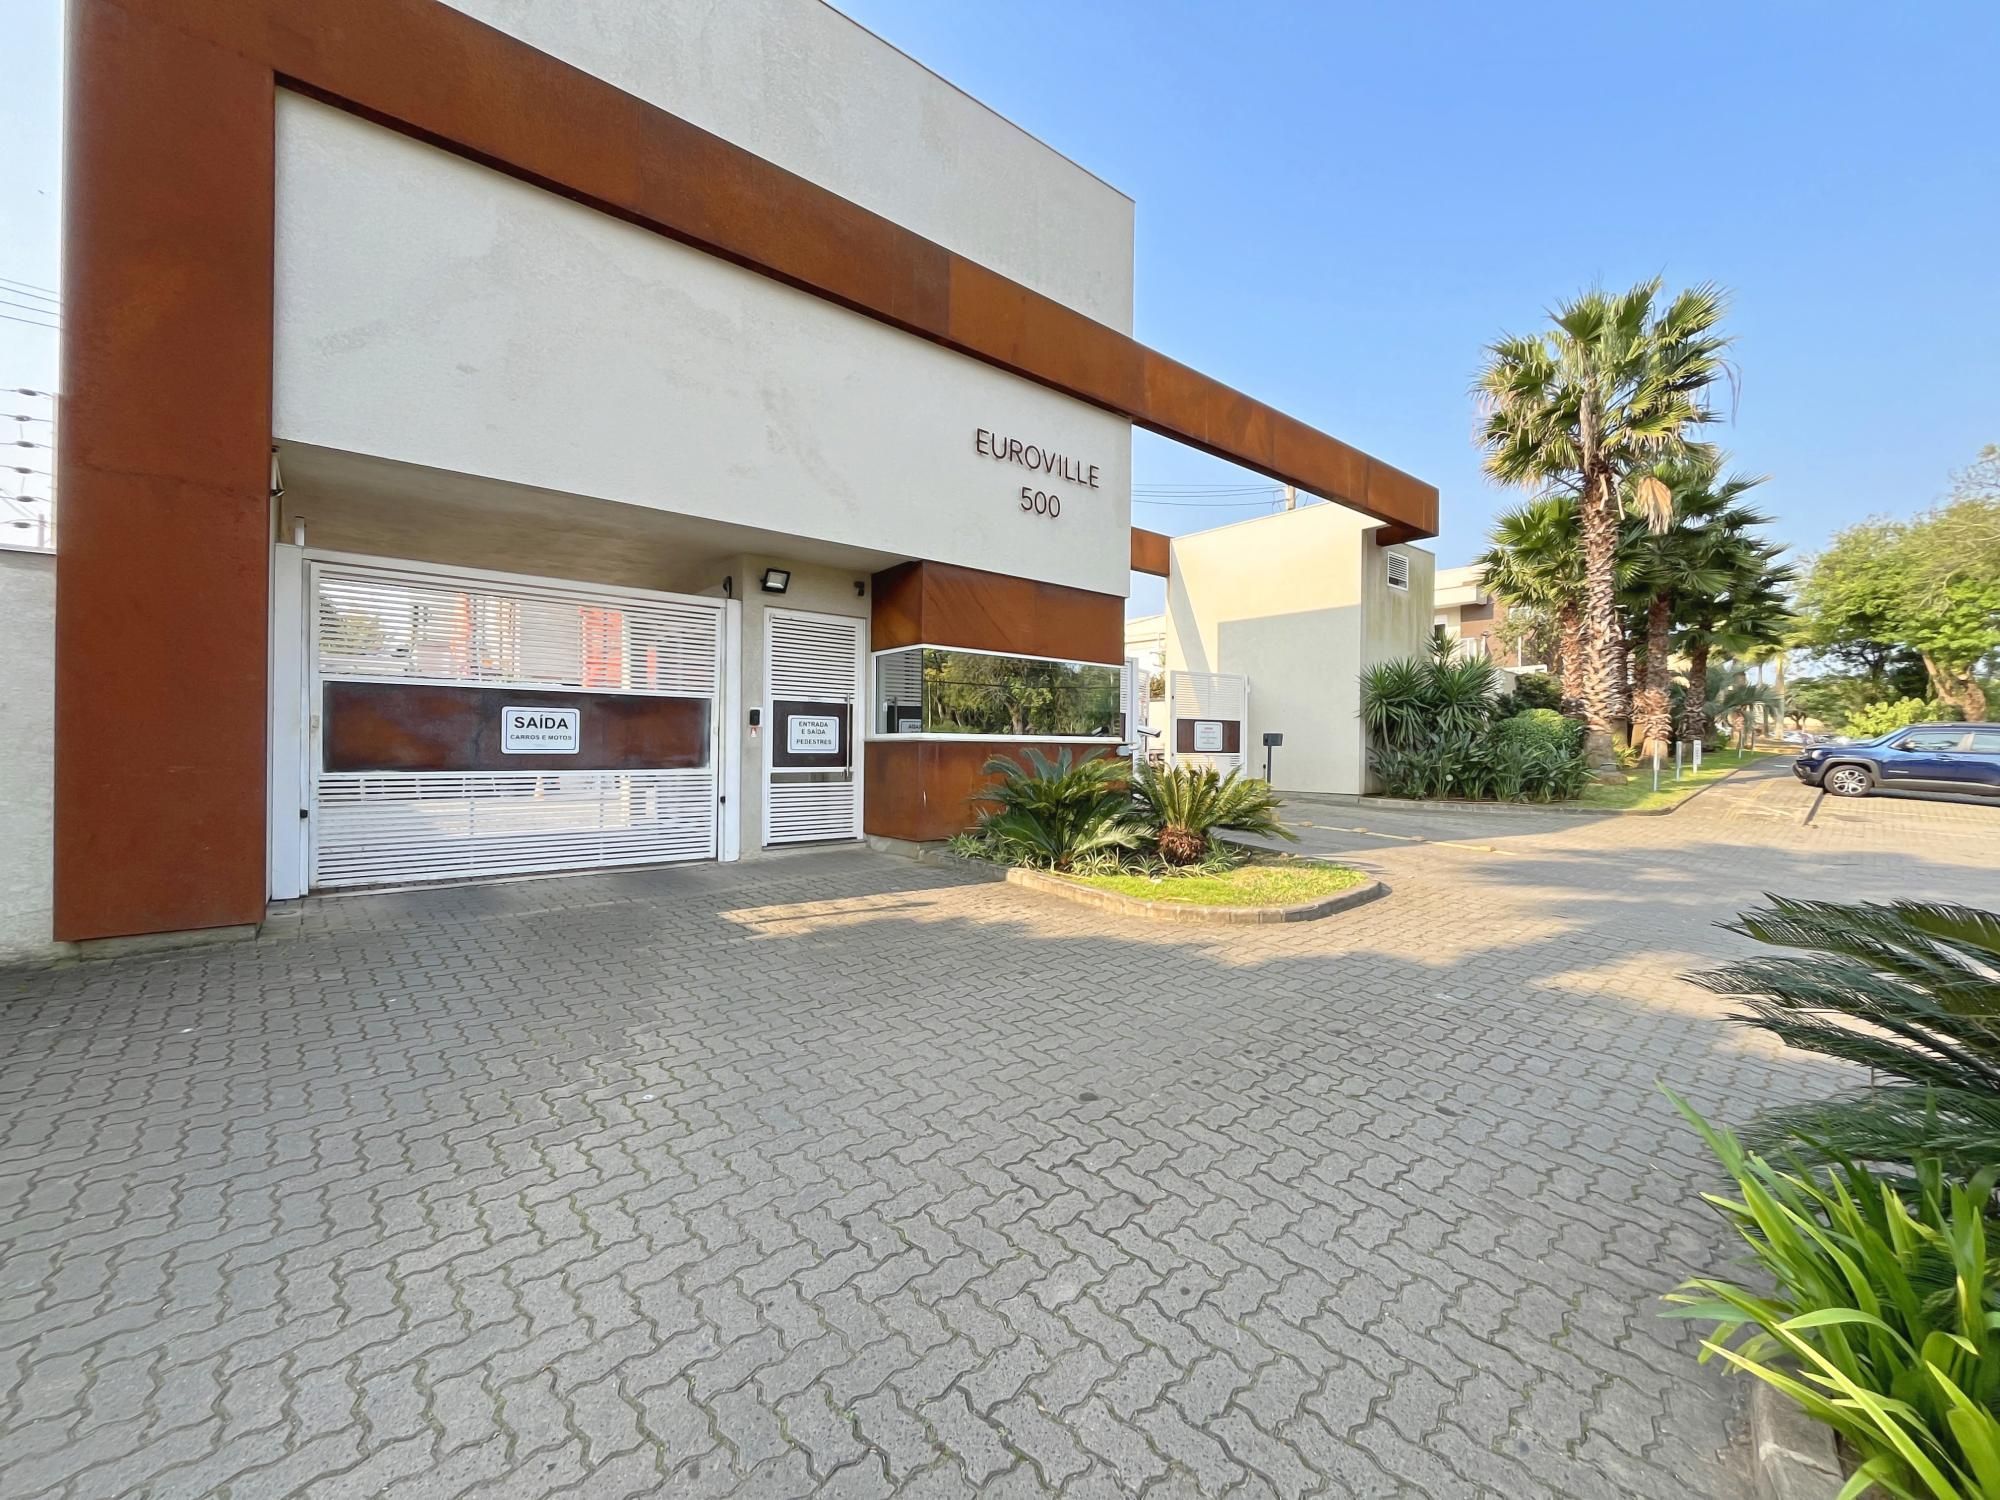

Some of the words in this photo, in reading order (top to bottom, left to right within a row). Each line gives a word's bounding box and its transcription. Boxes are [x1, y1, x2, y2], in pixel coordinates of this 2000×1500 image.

[976, 428, 1100, 489] EUROVILLE
[1020, 486, 1061, 518] 500
[514, 714, 569, 730] SAÍDA
